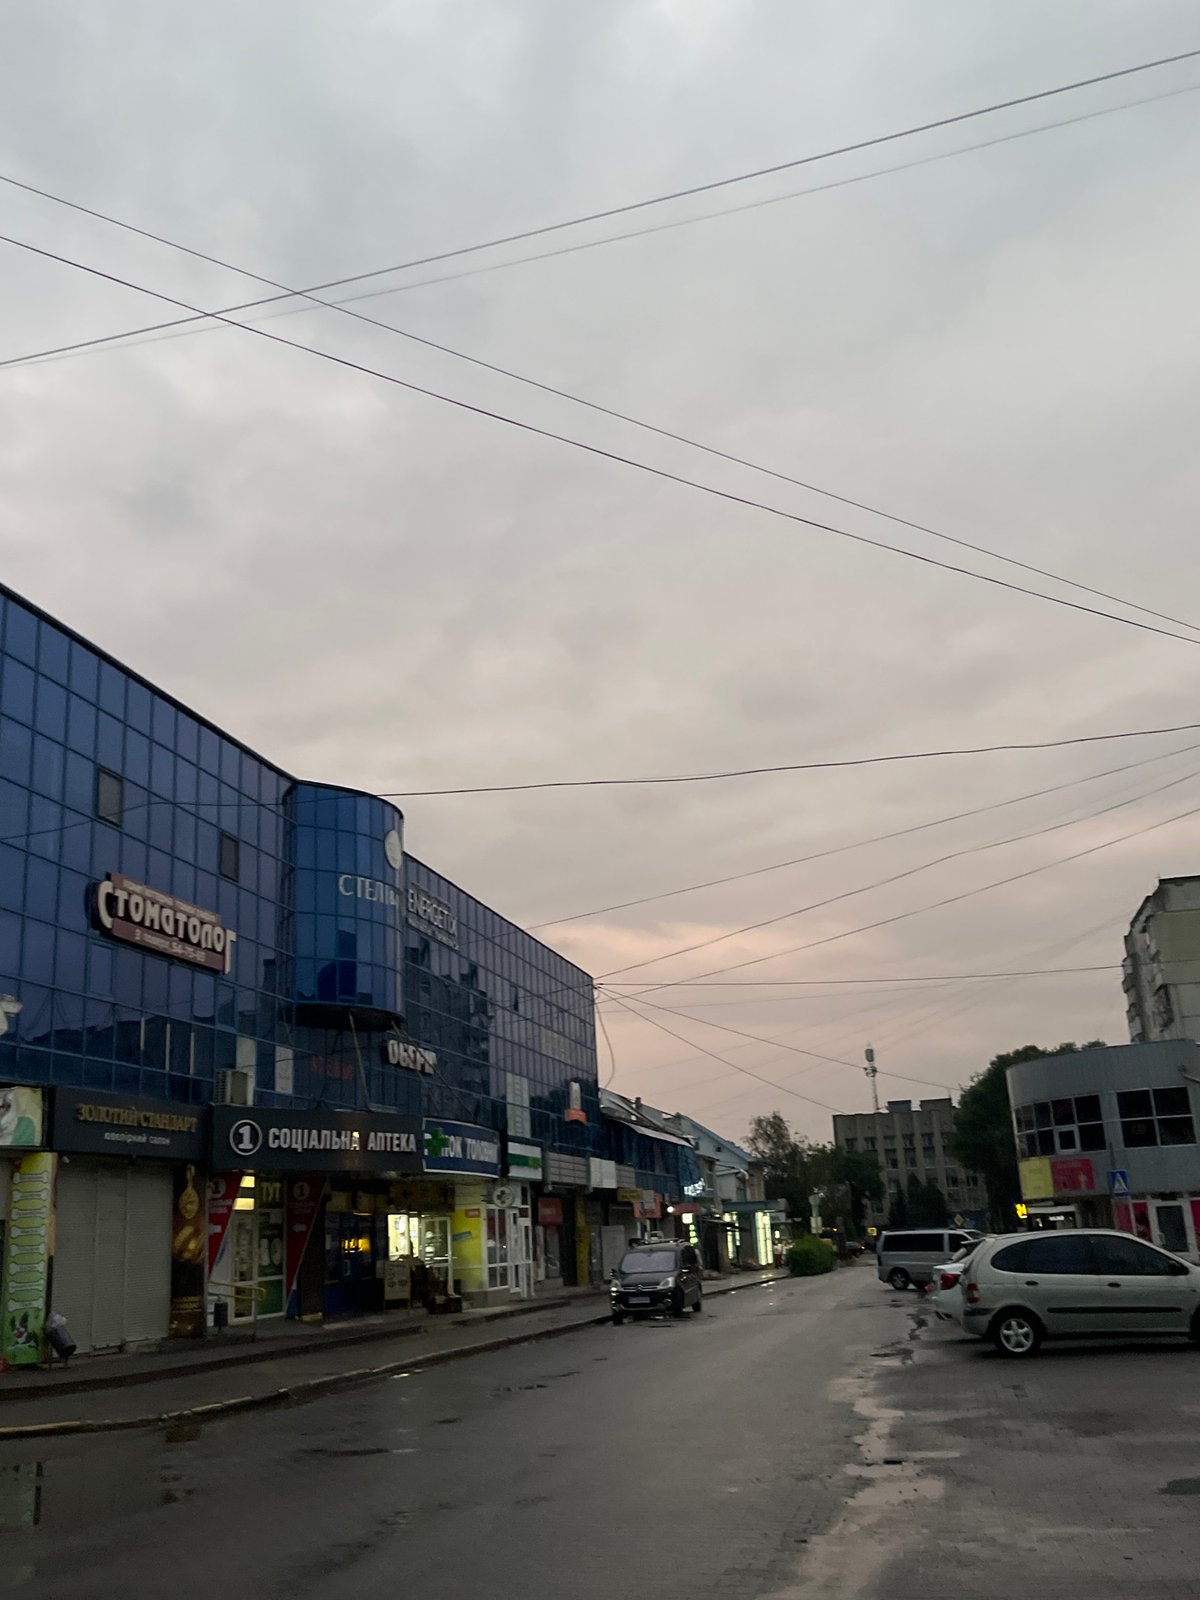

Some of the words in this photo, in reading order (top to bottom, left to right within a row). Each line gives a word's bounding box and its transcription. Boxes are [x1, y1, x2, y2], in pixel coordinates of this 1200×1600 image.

[238, 1125, 253, 1149] 1
[268, 1127, 360, 1152] СОЦІАЛЬНА
[367, 1131, 417, 1152] АПТЕКА
[261, 1181, 282, 1202] ТУТ
